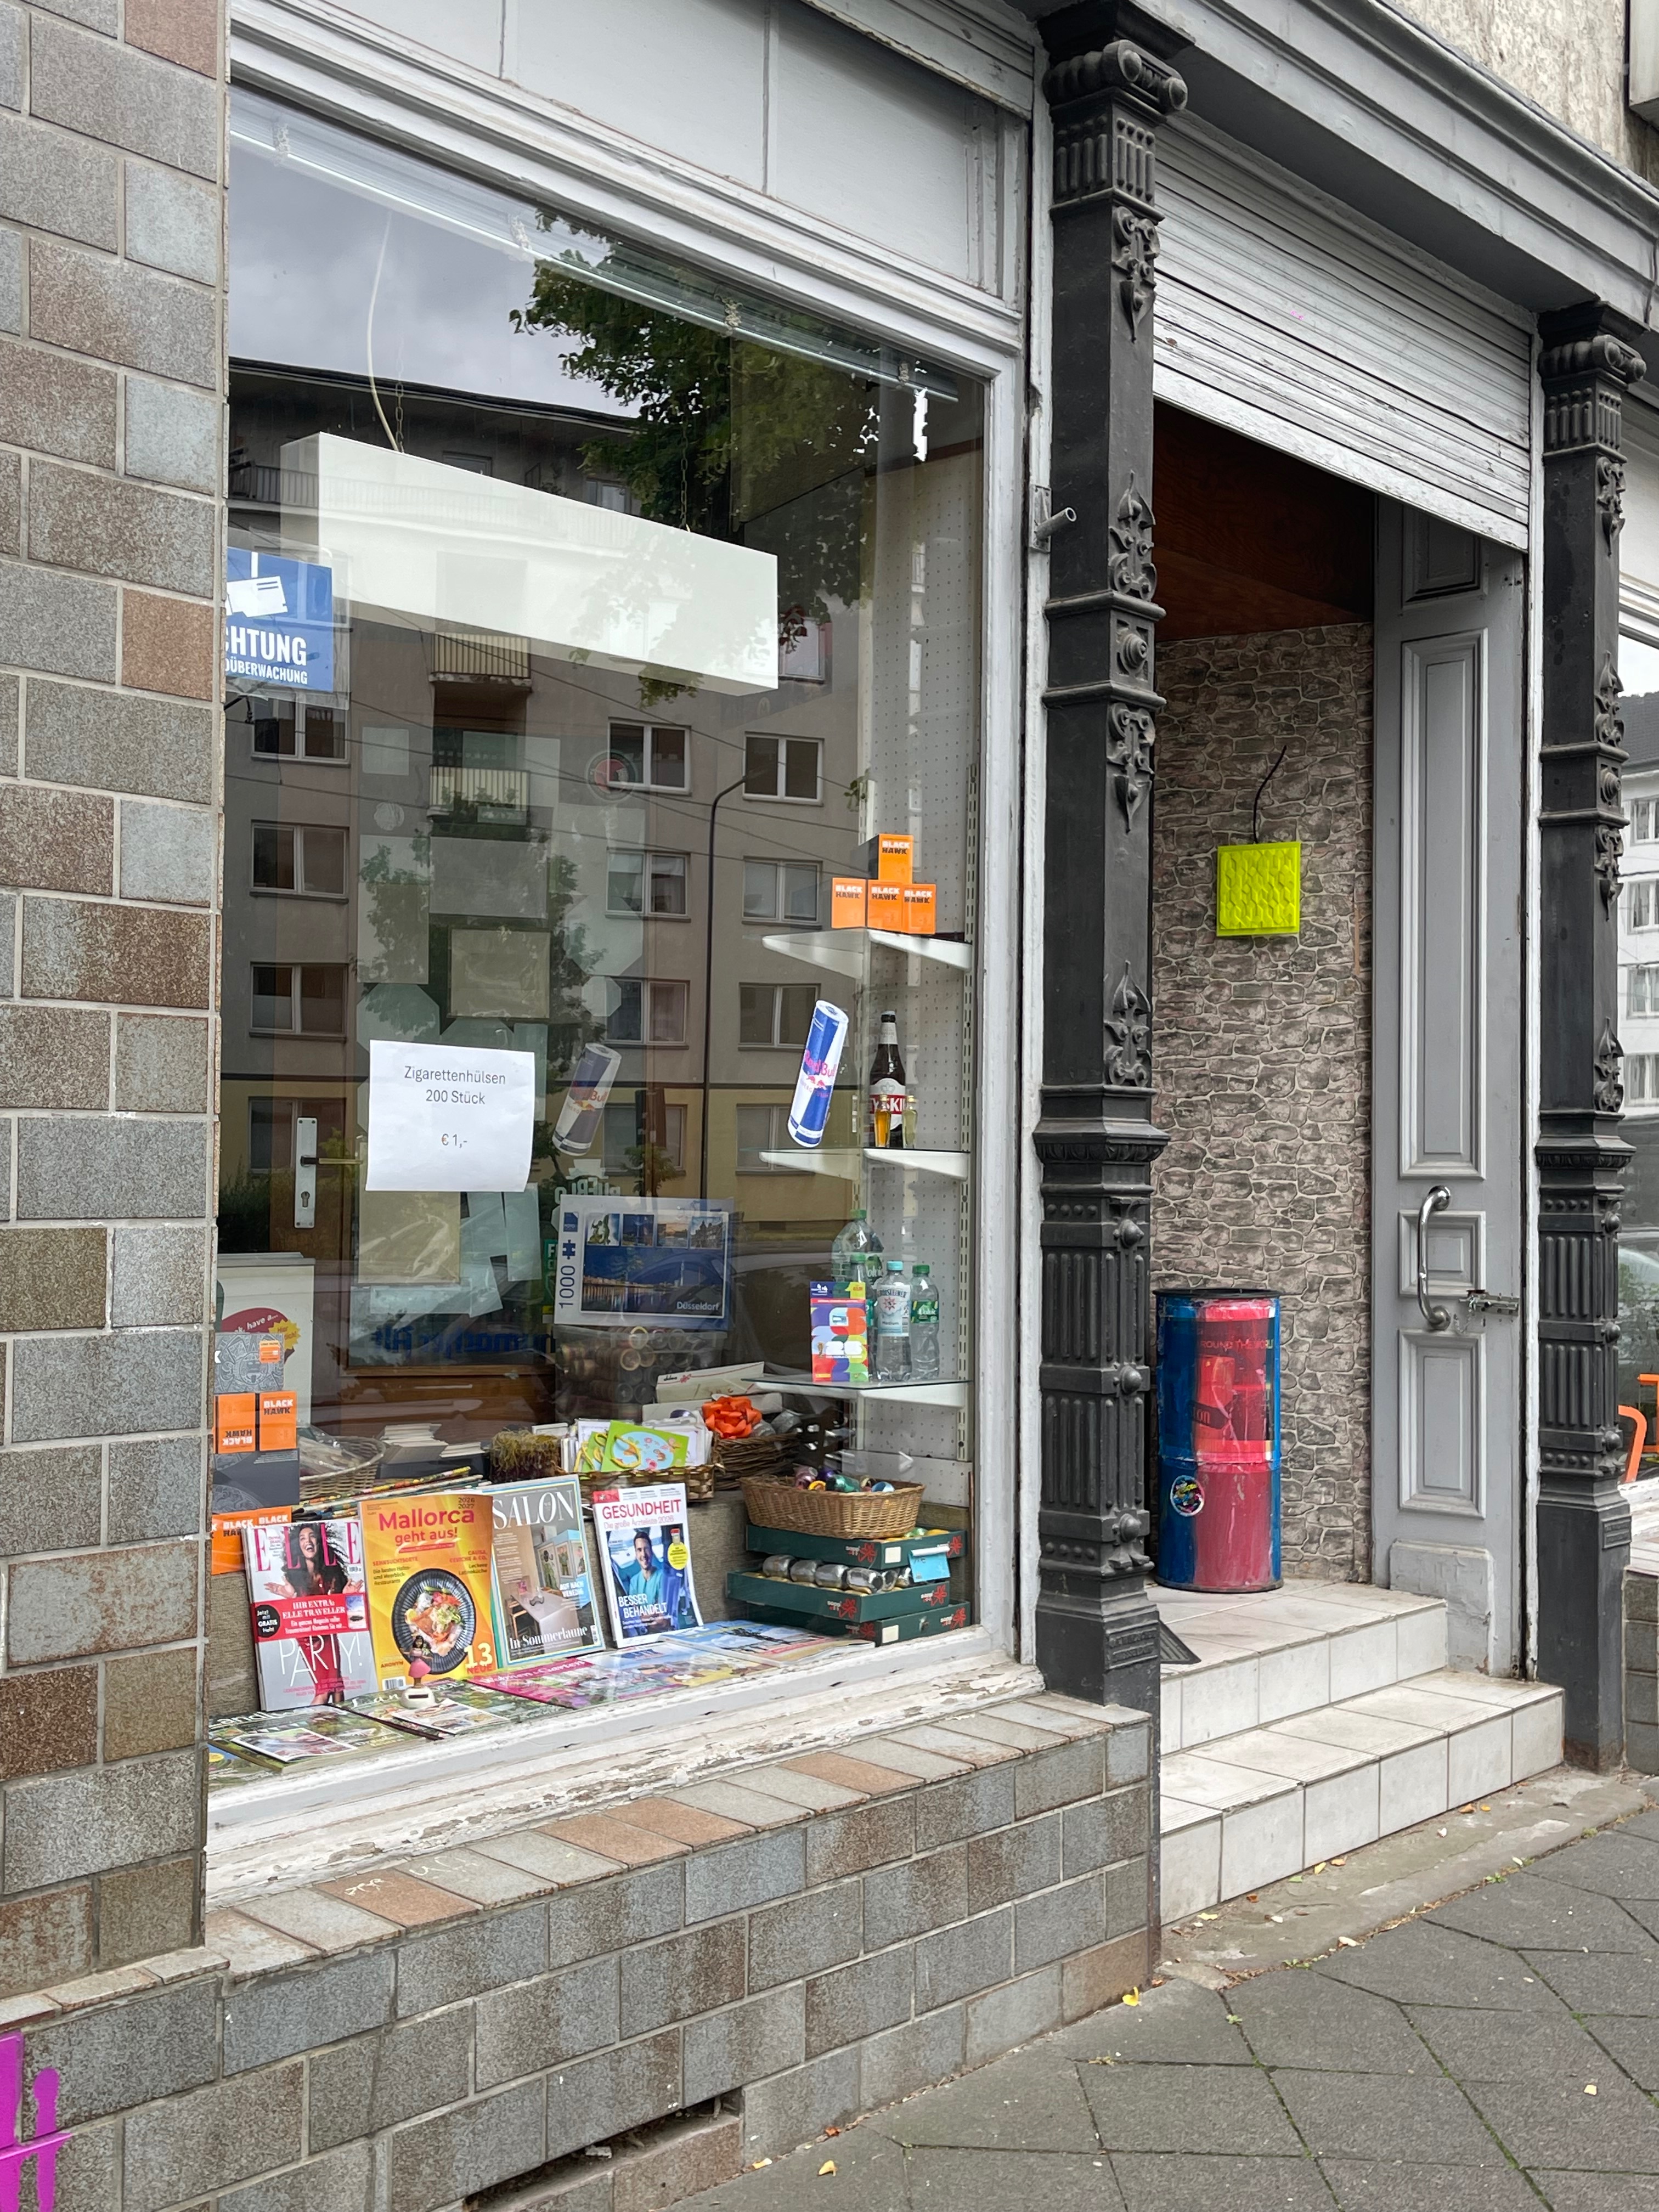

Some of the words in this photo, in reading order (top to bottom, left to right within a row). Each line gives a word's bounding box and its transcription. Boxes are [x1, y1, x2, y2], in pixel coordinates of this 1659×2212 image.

[225, 625, 307, 666] HTUNG
[882, 840, 910, 849] BLACK
[835, 884, 862, 893] BLACK
[871, 886, 900, 895] BLACK
[904, 890, 933, 898] BLACK
[404, 1066, 506, 1085] Zigarettenhülsen
[425, 1090, 448, 1102] 200
[451, 1091, 486, 1105] Stück
[441, 1133, 449, 1146] €
[559, 1265, 576, 1310] 1000
[676, 1301, 720, 1311] Düsseldorf
[247, 1317, 266, 1330] have
[263, 1399, 294, 1408] BLACK
[225, 1429, 252, 1437] HAWK
[222, 1436, 252, 1446] BLACK
[492, 1490, 574, 1530] SALON
[602, 1499, 681, 1520] GESUNDHEIT
[223, 1519, 254, 1530] BLACK
[258, 1514, 288, 1525] BLACK
[379, 1508, 475, 1531] Mallorca
[604, 1521, 613, 1530] Die
[615, 1520, 630, 1530] große
[394, 1530, 425, 1547] geht
[429, 1527, 458, 1541] aus!
[253, 1521, 362, 1572] ELLE
[618, 1593, 648, 1607] BESSER
[282, 1611, 303, 1619] ELLE
[303, 1606, 346, 1616] TRAVELLER
[623, 1602, 668, 1618] BEHANDELT
[510, 1638, 521, 1649] In
[522, 1627, 588, 1646] Sommerlaune
[278, 1633, 363, 1687] PARTY!
[464, 1643, 493, 1669] 13
